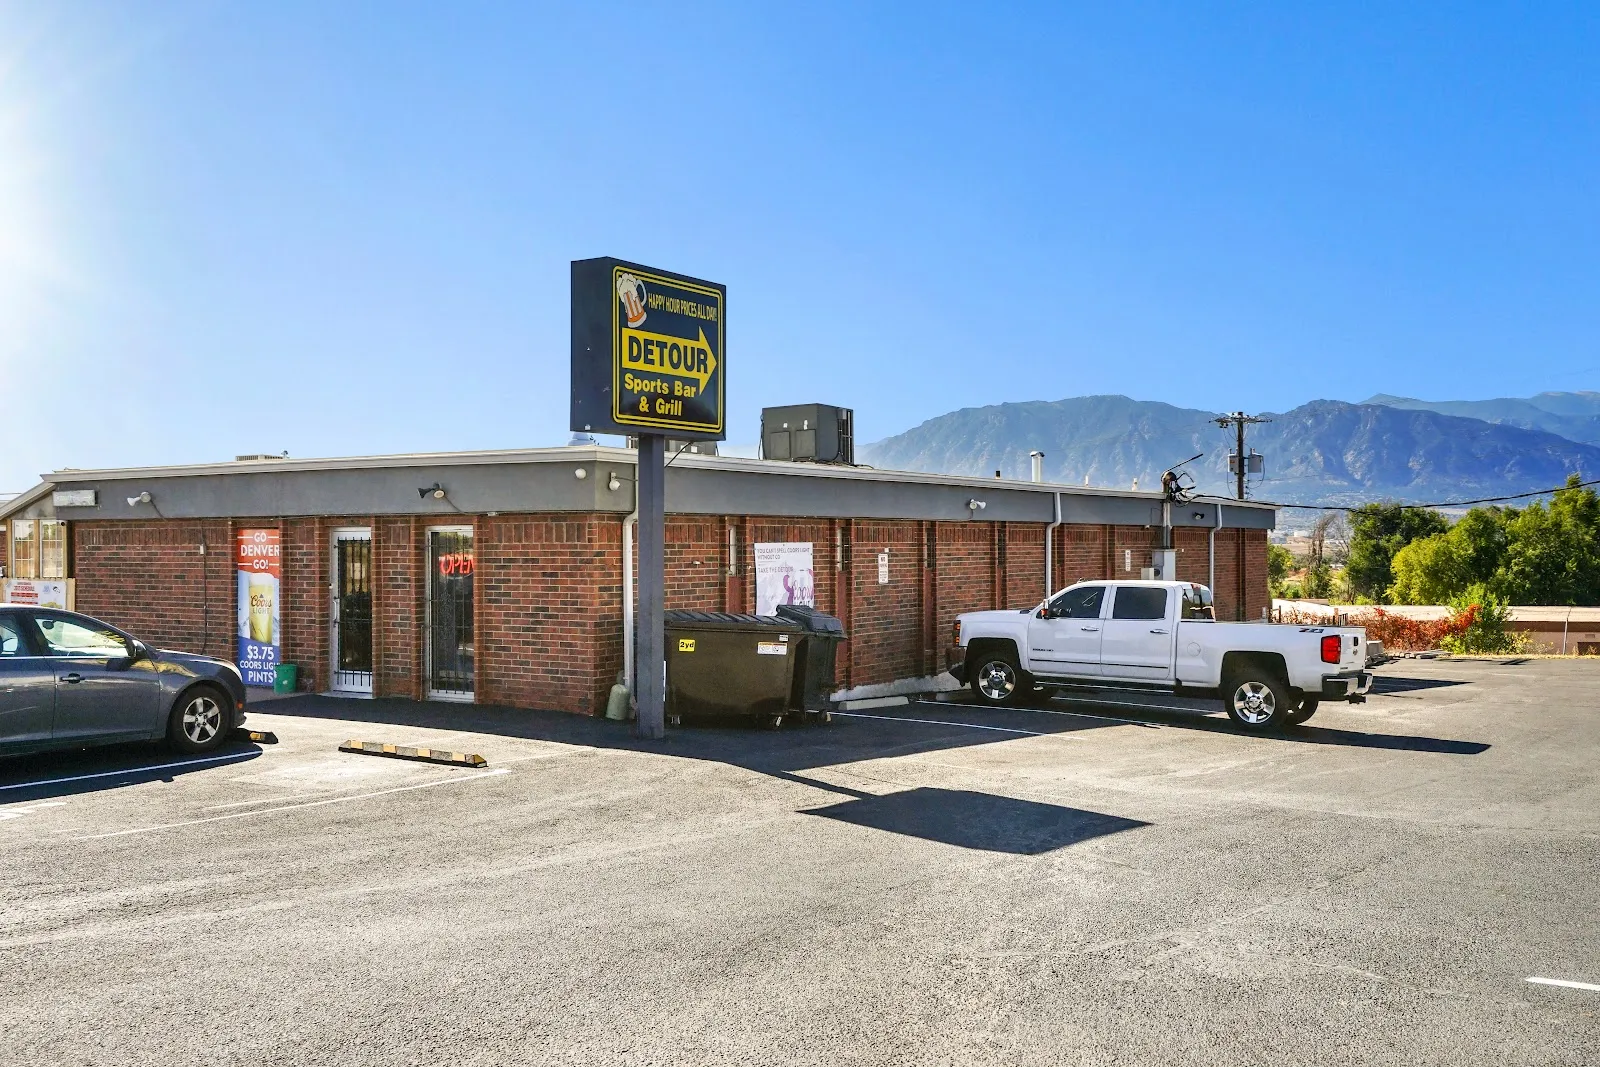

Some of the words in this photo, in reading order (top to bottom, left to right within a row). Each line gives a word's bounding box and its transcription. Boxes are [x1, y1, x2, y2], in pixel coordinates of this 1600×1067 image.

[648, 293, 666, 311] HAPPY
[665, 296, 681, 315] HOUR
[681, 300, 697, 317] PRICES
[697, 303, 707, 320] ALL
[628, 335, 708, 374] DETOUR
[624, 373, 669, 394] Sports
[674, 381, 696, 398] Bar
[639, 396, 650, 413] &
[655, 398, 682, 417] Grill
[254, 532, 267, 543] GO
[240, 544, 280, 556] DENVER
[253, 559, 269, 569] GO!
[250, 594, 272, 608] Coors
[247, 644, 275, 661] $3.75
[239, 660, 262, 670] COORS
[263, 661, 280, 670] LIG
[248, 670, 274, 684] PINTS
